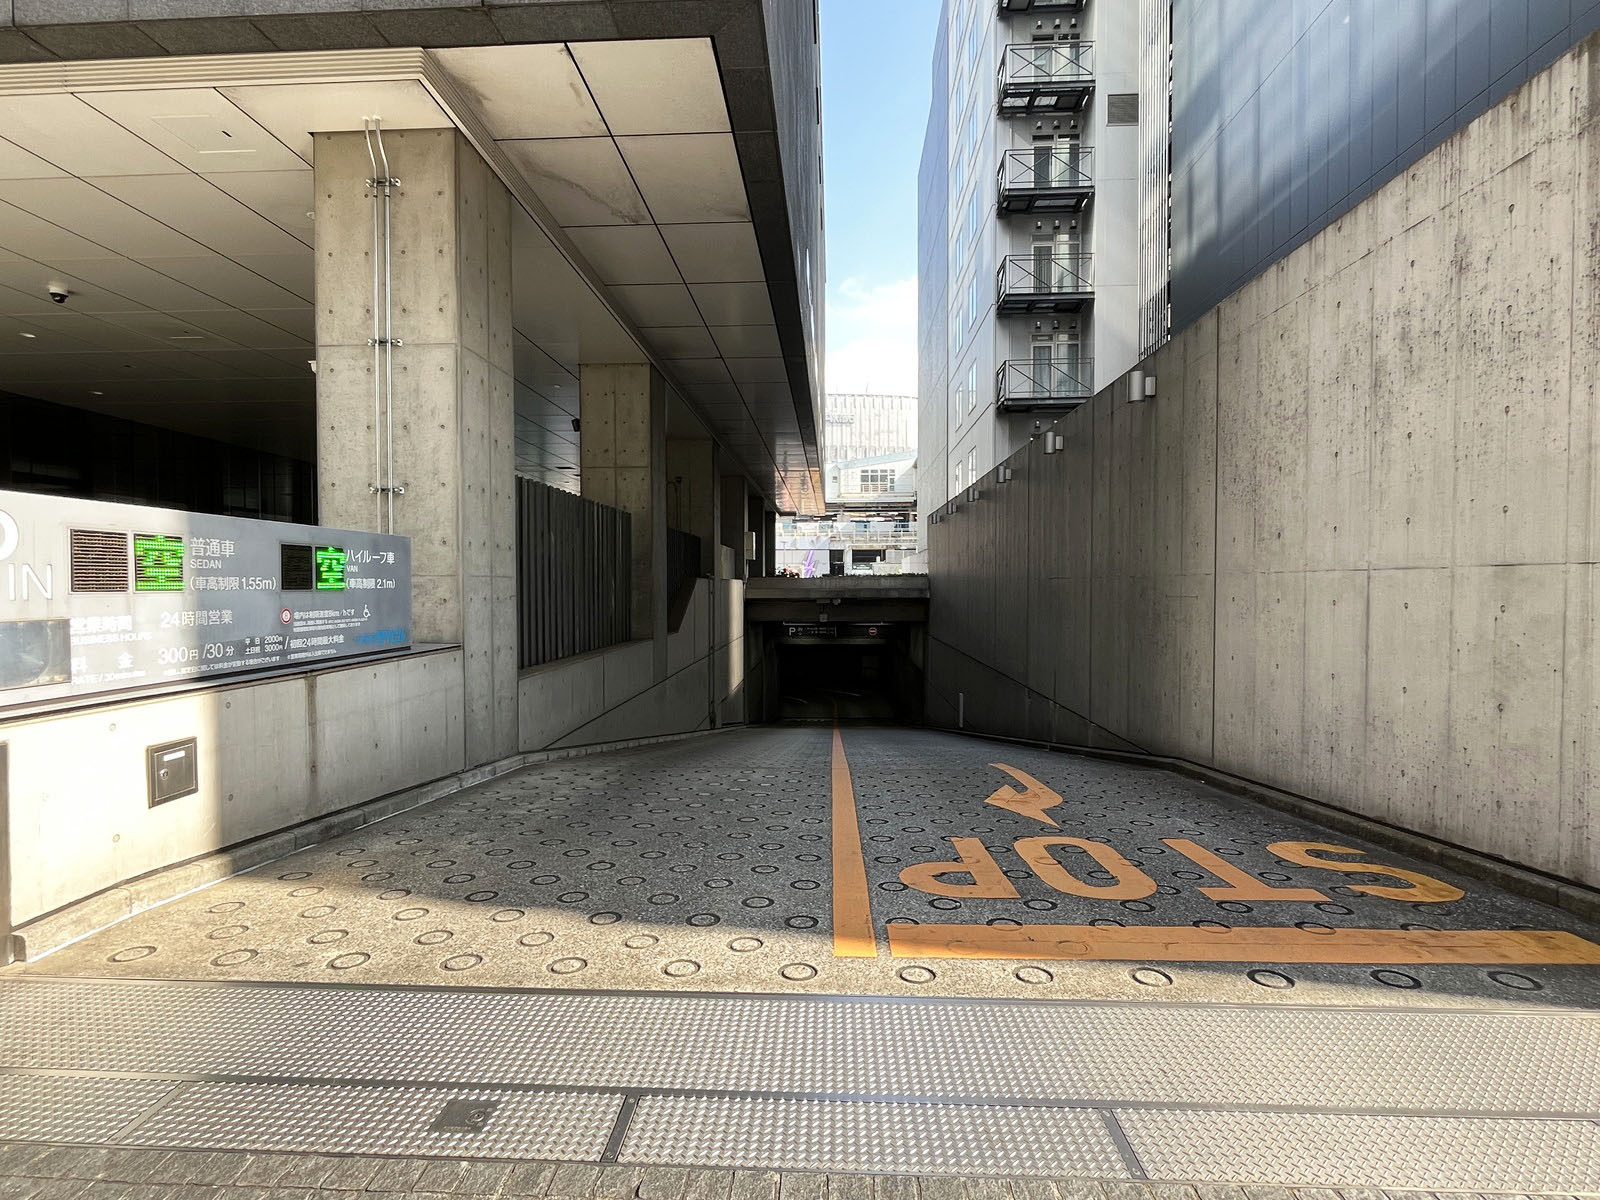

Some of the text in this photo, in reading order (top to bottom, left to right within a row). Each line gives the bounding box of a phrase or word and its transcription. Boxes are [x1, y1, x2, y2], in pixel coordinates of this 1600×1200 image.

[190, 537, 235, 557] 普通車
[190, 559, 222, 568] SEDAN
[346, 550, 395, 564] ハイルーフ車
[8, 563, 53, 601] IN
[161, 609, 233, 628] 24時間営業
[900, 837, 1466, 901] STOP
